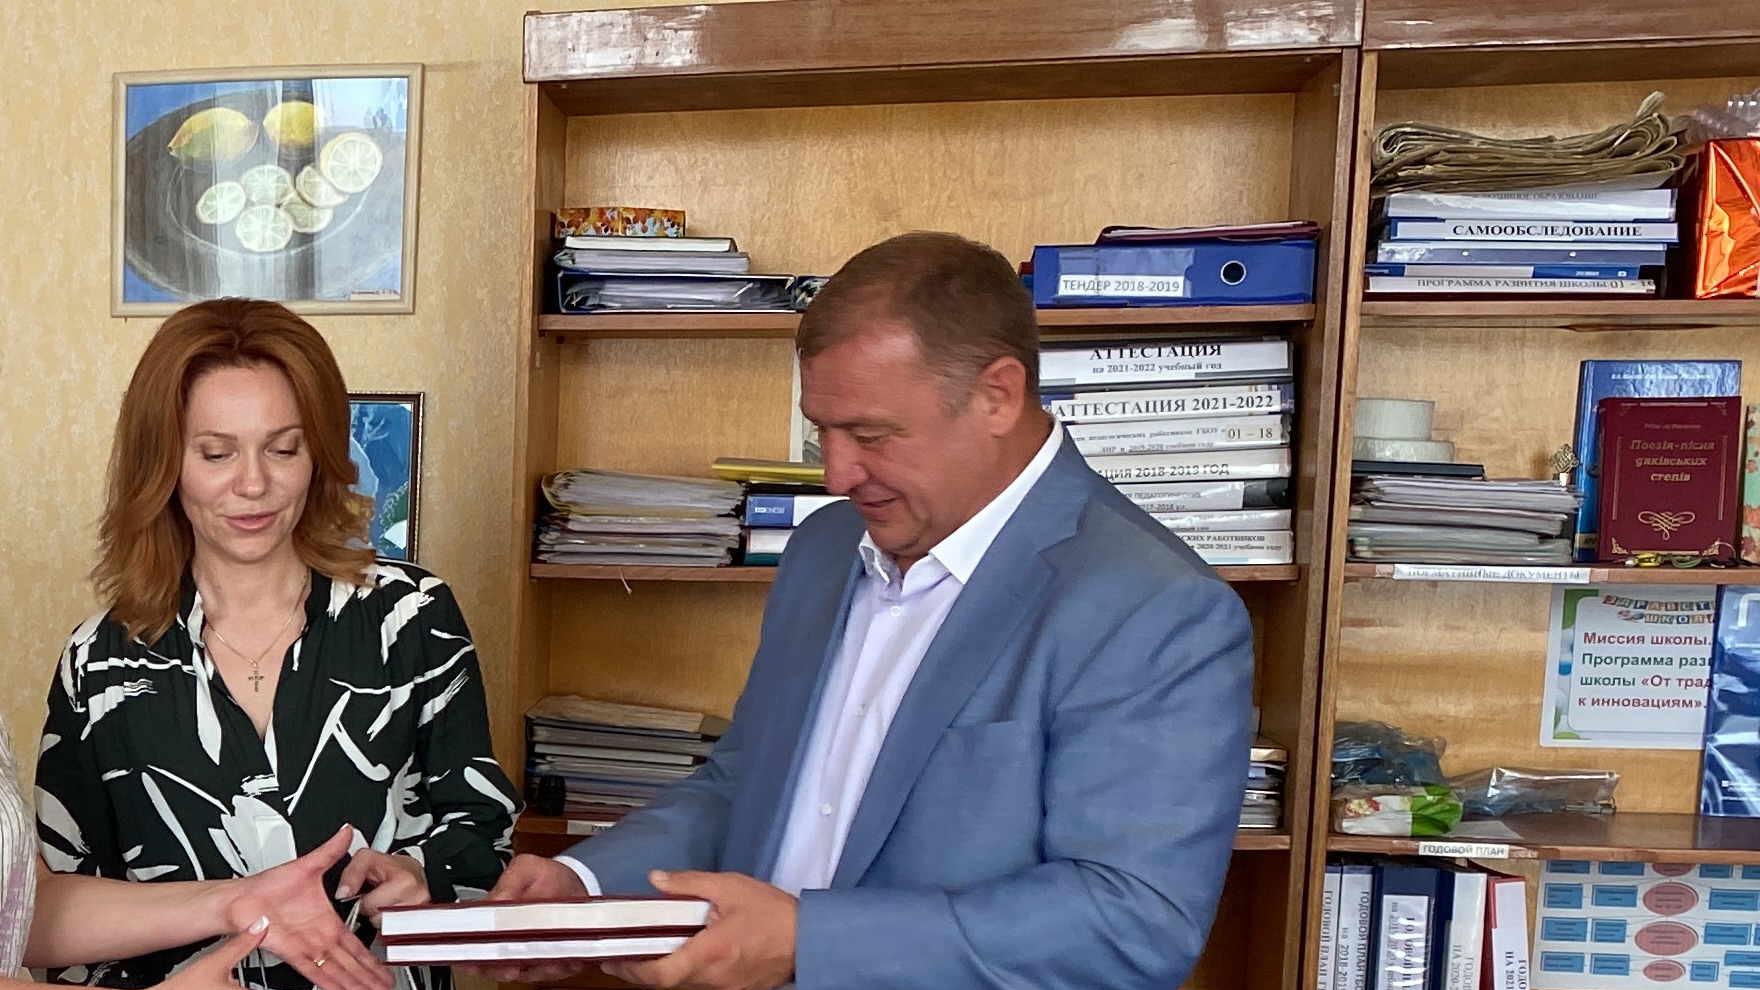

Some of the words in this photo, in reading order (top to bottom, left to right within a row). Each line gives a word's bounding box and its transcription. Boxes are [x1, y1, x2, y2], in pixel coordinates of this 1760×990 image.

[1452, 224, 1643, 237] САМООБСЛЕДОВАНИЕ
[1063, 280, 1112, 292] ТЕНДЕР
[1114, 280, 1180, 292] 2018-2019
[1417, 278, 1492, 288] ПРОГРАММА
[1494, 279, 1556, 288] РАЗВИТИЯ
[1559, 279, 1608, 288] ШКОЛЫ
[1089, 344, 1222, 361] АТТЕСТАЦИЯ
[1107, 363, 1156, 373] 2021-2022
[1158, 362, 1203, 373] учебный
[1205, 362, 1223, 370] год
[1054, 398, 1186, 417] АТТЕСТАЦИЯ
[1192, 395, 1274, 411] 2021-2022
[1227, 428, 1241, 439] 01
[1259, 428, 1273, 438] 18
[1630, 439, 1715, 450] Поезія-пісня
[1136, 465, 1200, 478] 2018-2019
[1202, 463, 1230, 476] ГОД
[1650, 472, 1691, 482] степів
[1603, 595, 1716, 612] ЗДРАВСТ
[1583, 632, 1645, 645] Миссия
[1650, 635, 1712, 646] школы.
[1582, 653, 1674, 668] Программа
[1580, 676, 1636, 687] школы
[1641, 674, 1671, 687] «От
[1577, 698, 1586, 707] к
[1591, 698, 1708, 709] инновациям».
[1423, 844, 1473, 855] ГОДОВОЙ
[1475, 846, 1505, 856] ПЛАН
[1321, 890, 1333, 943] ГОДОВОЙ
[1359, 891, 1370, 941] ГОДОВОЙ
[1356, 943, 1367, 972] ПЛАН
[1452, 945, 1463, 960] НА
[1505, 951, 1515, 966] НА
